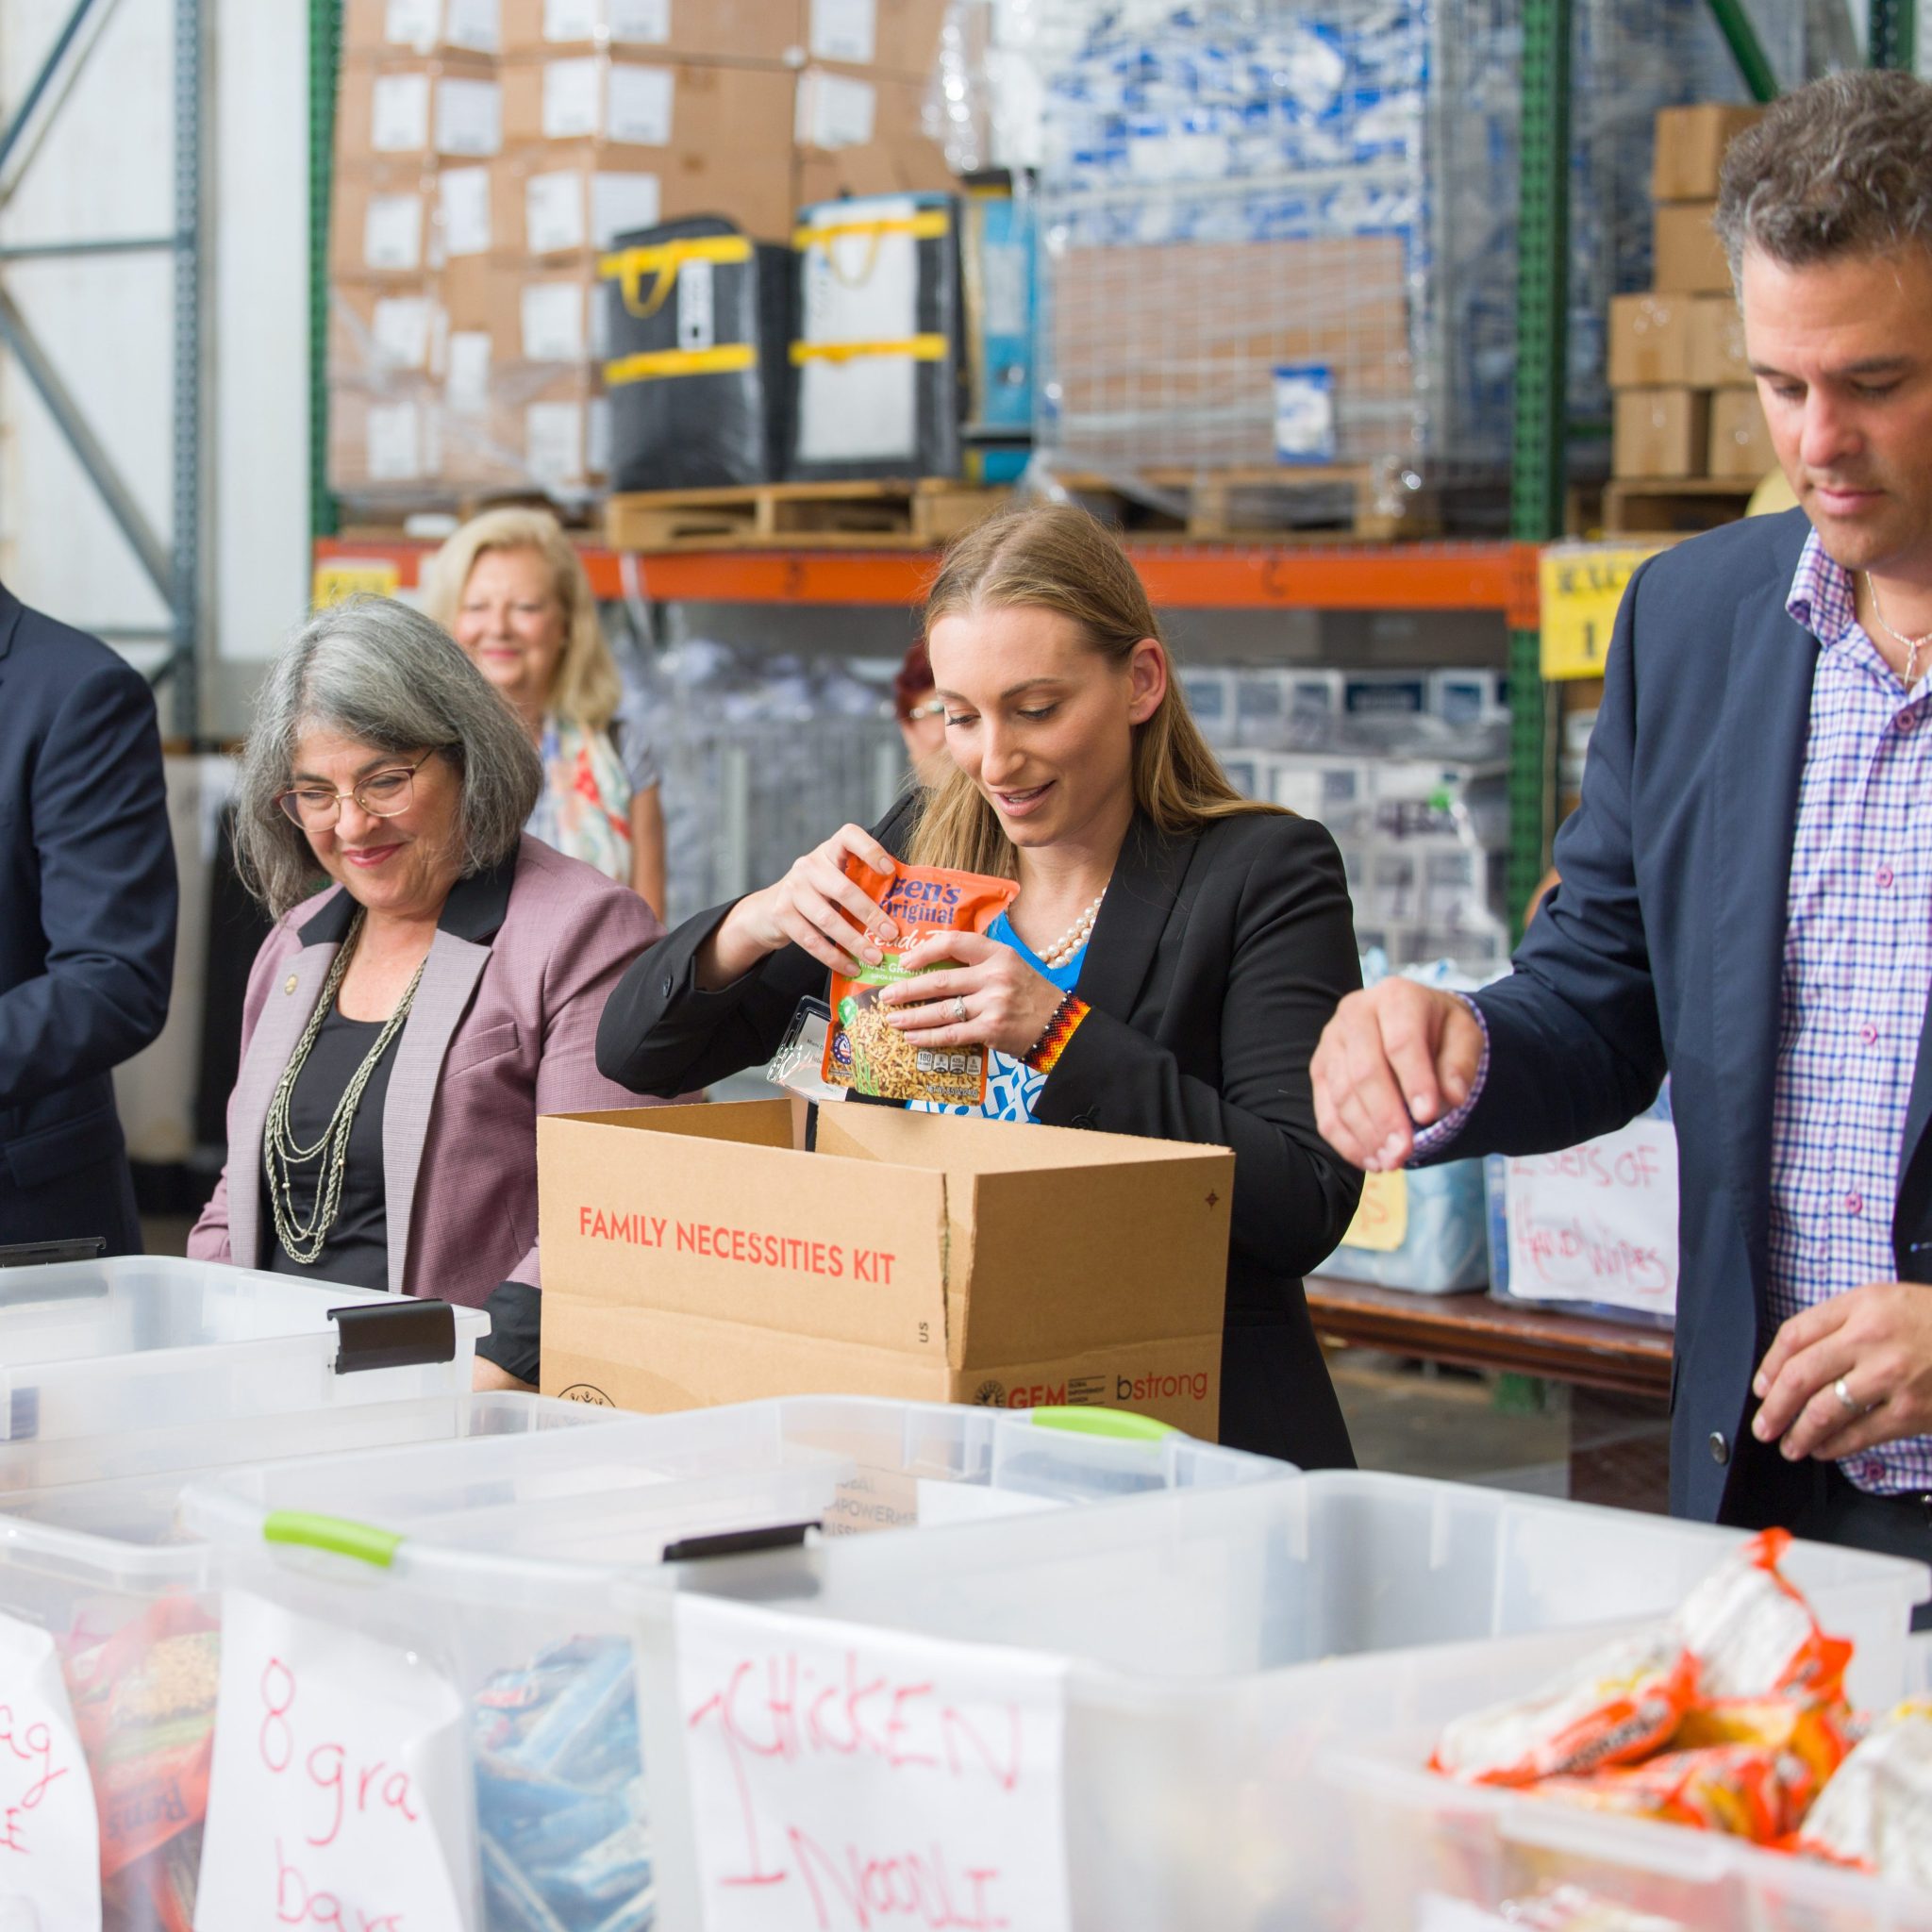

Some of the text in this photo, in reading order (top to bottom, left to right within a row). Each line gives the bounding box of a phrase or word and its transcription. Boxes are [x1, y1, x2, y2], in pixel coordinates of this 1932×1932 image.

[878, 899, 955, 925] Original
[1614, 1144, 1659, 1188] OF
[579, 1207, 895, 1285] FAMILY NECESSITIES KIT
[1117, 1373, 1208, 1401] bstrong
[259, 1657, 295, 1773] 8
[0, 1704, 69, 1808] ag
